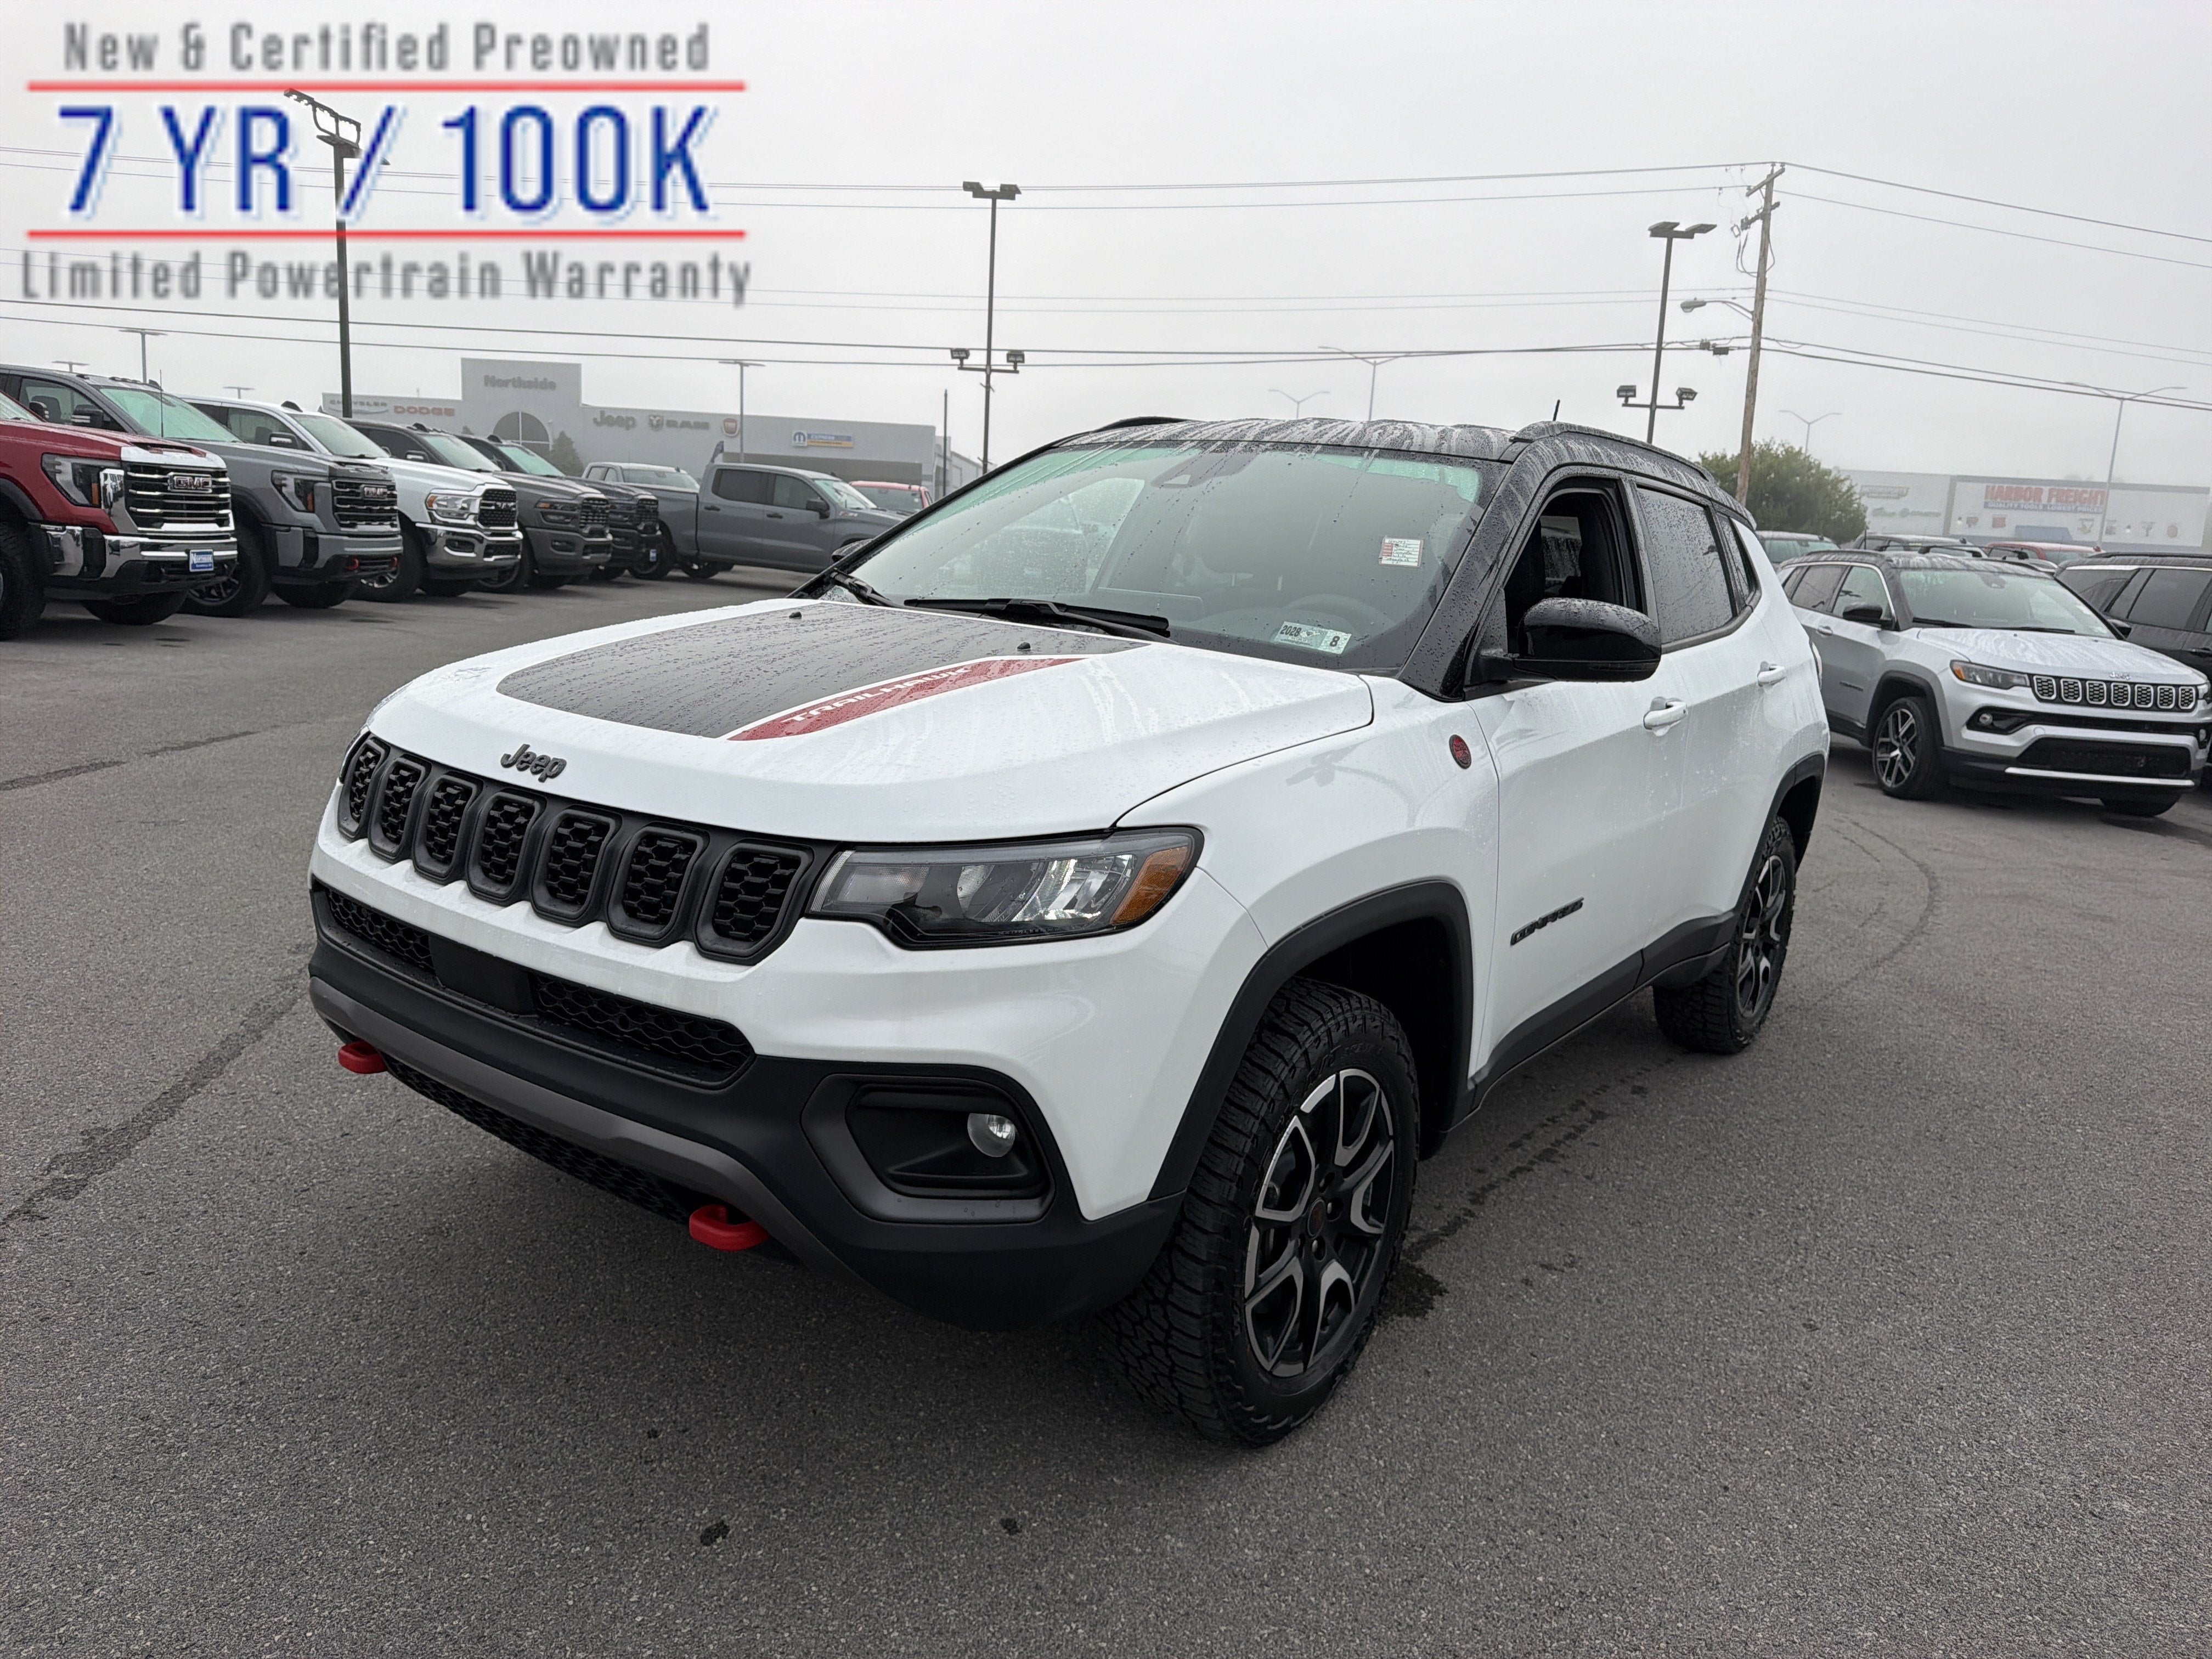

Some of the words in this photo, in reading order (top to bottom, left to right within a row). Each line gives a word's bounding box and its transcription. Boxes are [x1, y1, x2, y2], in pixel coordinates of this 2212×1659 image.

[484, 375, 556, 390] Northside
[330, 399, 387, 407] CHYSLER
[393, 405, 455, 416] DODGE
[592, 410, 636, 431] Jeep
[665, 420, 709, 430] RAM
[173, 476, 212, 489] GMC
[1985, 484, 2044, 503] HARBOR
[1279, 625, 1302, 637] 2028
[1329, 635, 1340, 647] 8
[2109, 671, 2131, 680] Jeep
[780, 667, 972, 724] TRAILHAWK
[500, 743, 567, 783] Jeep
